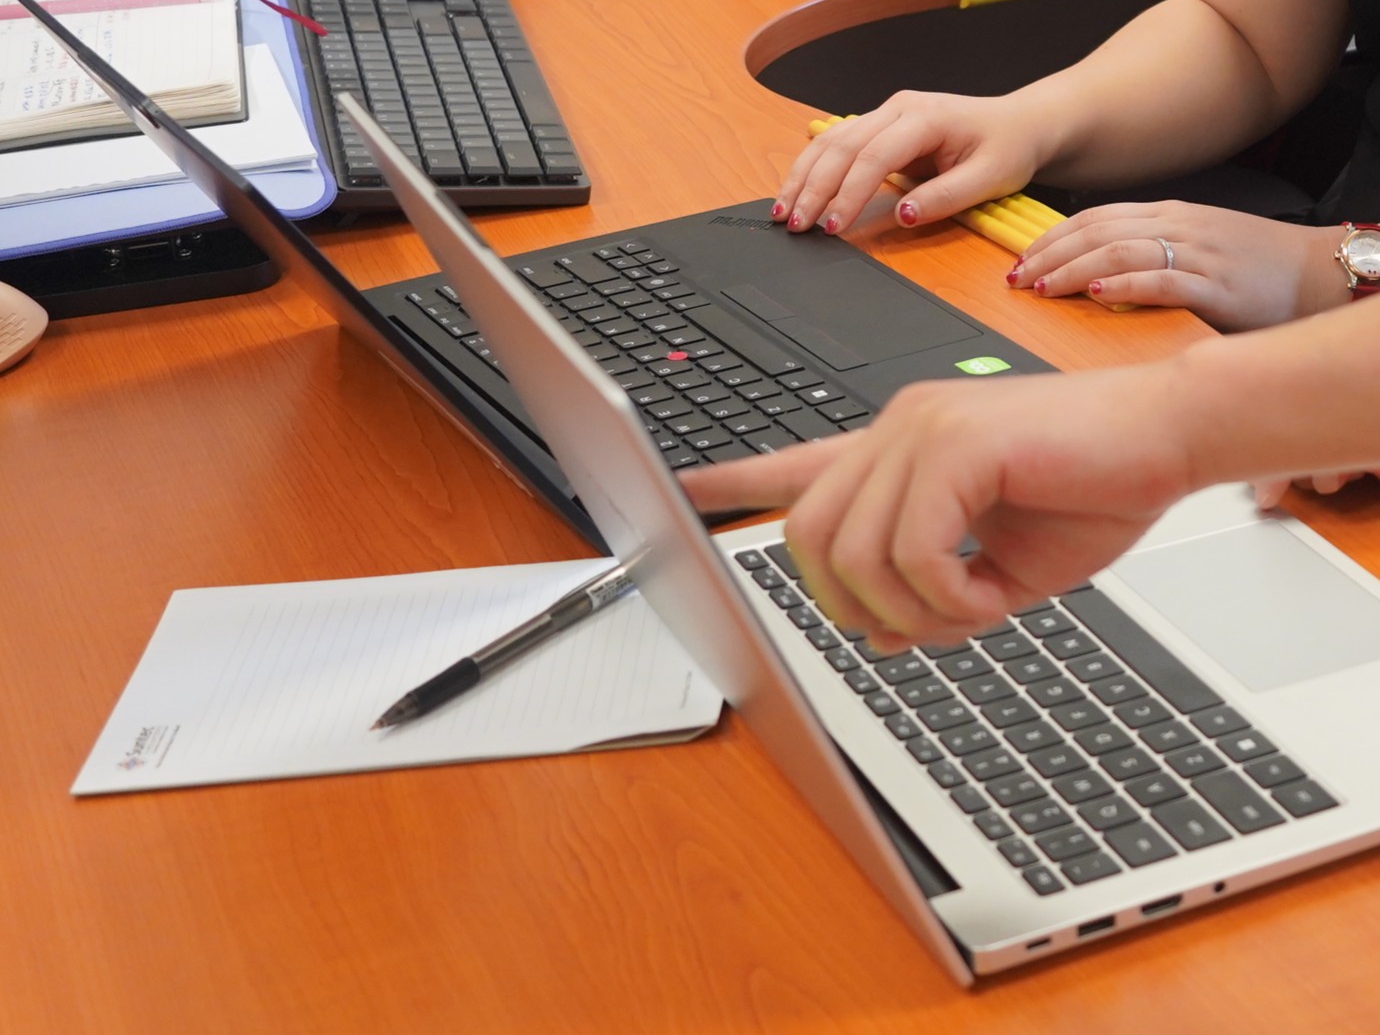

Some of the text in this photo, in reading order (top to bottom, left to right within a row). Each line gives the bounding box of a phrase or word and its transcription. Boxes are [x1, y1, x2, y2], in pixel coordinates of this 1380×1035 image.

[655, 323, 667, 331] M
[748, 391, 760, 399] X
[677, 425, 690, 433] W
[697, 439, 709, 447] Q
[1025, 664, 1039, 673] H
[1047, 686, 1062, 695] G
[1096, 734, 1112, 743] D
[1121, 758, 1137, 767] S
[1148, 783, 1162, 792] A
[1041, 618, 1055, 627] M
[1064, 639, 1078, 648] N
[1111, 685, 1125, 693] V
[1135, 707, 1150, 716] C
[1162, 731, 1176, 739] X
[1186, 755, 1203, 764] Z
[1002, 708, 1016, 716] T
[1026, 731, 1040, 740] R
[1050, 755, 1066, 765] E
[1075, 780, 1090, 791] W
[1100, 805, 1117, 817] Q
